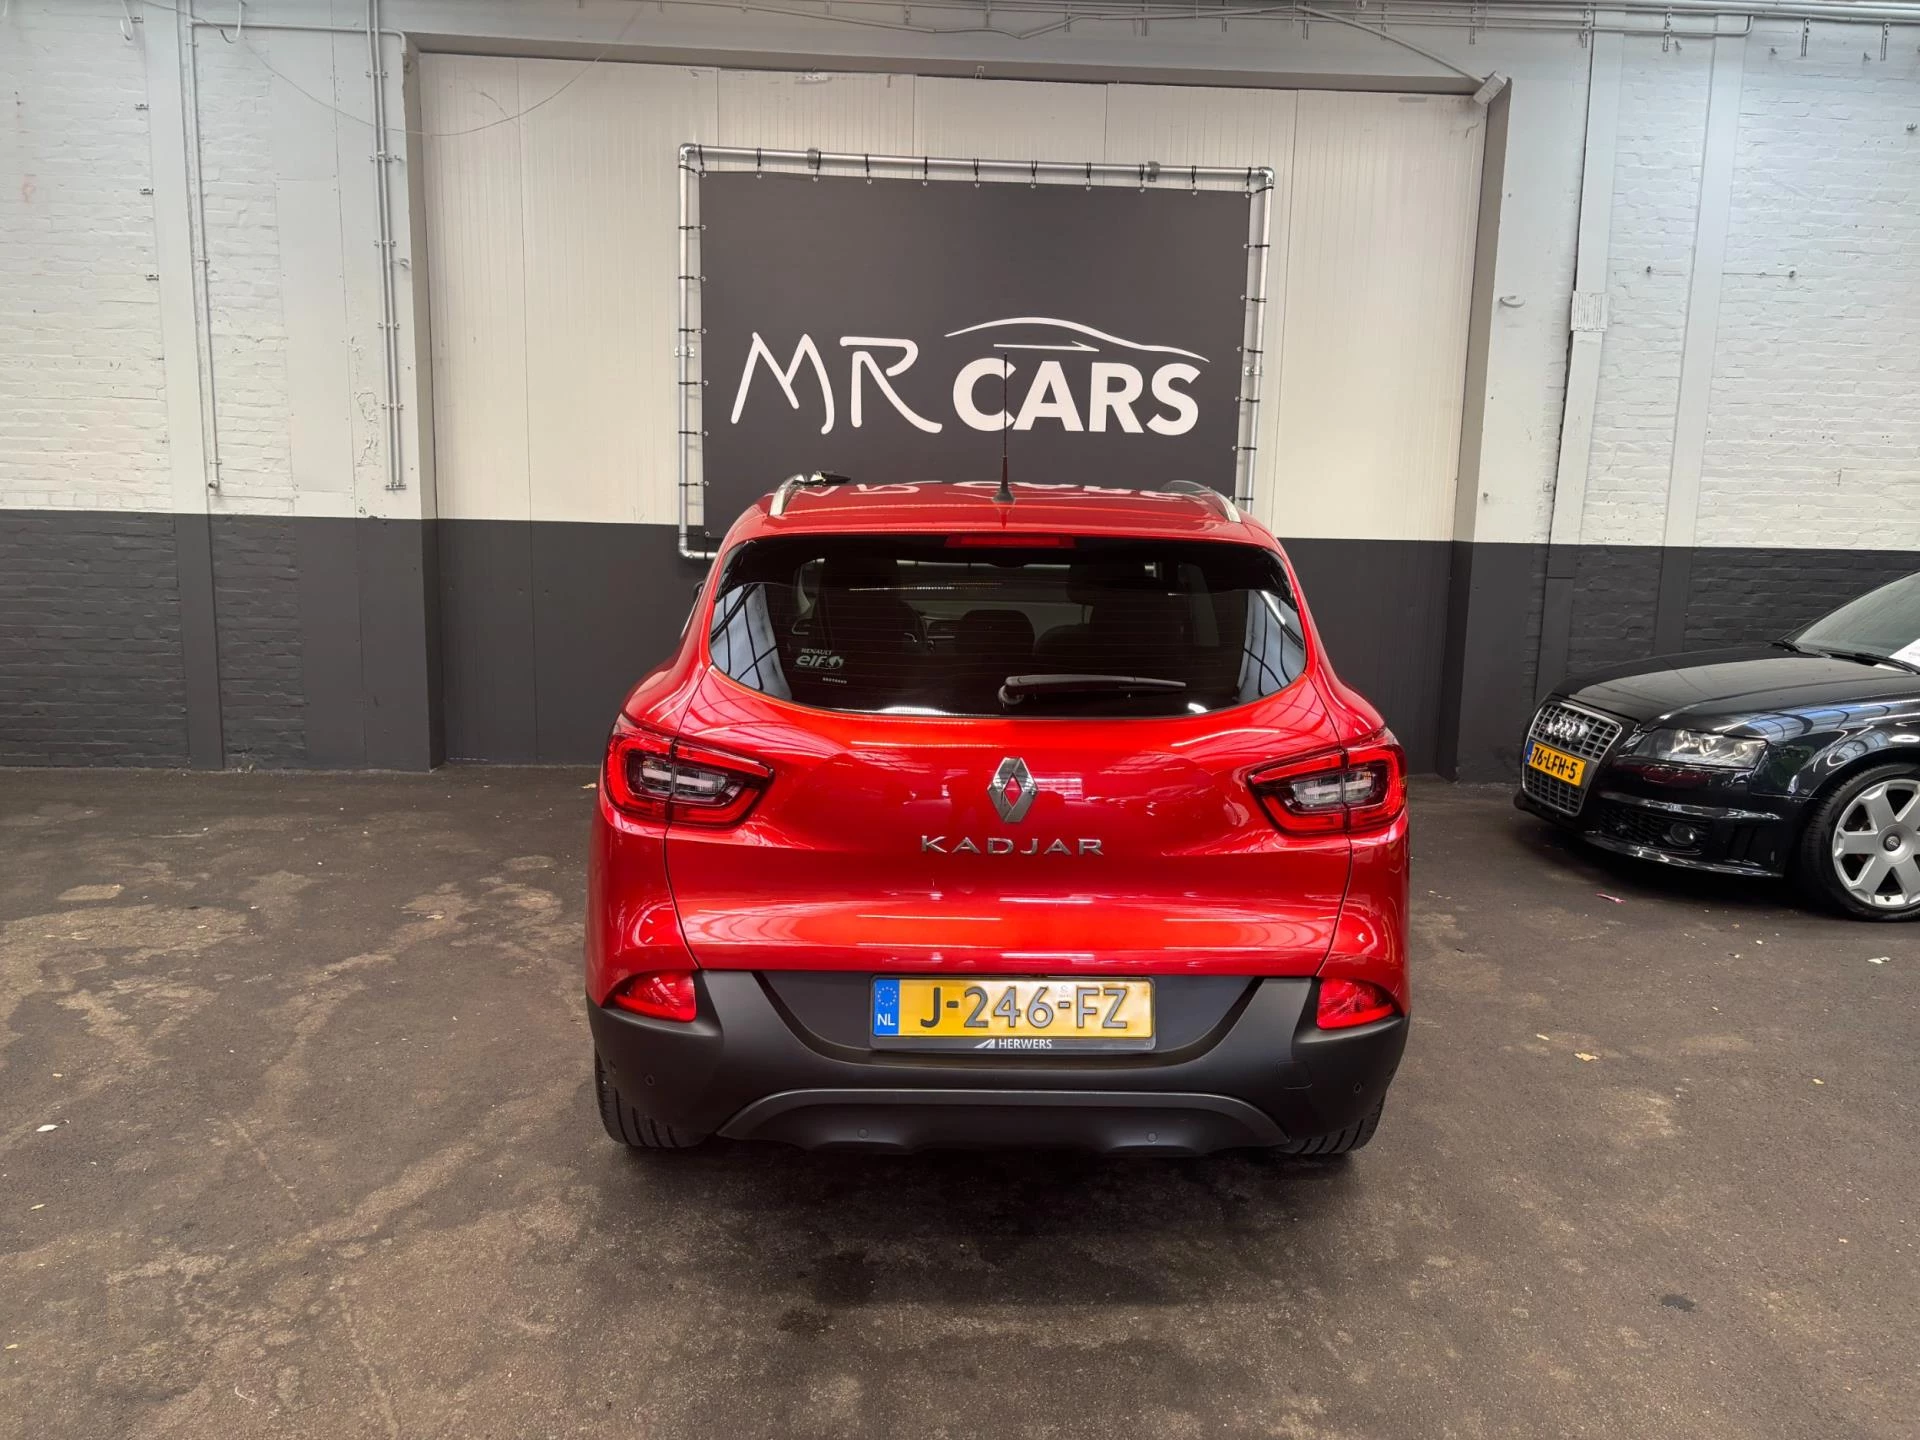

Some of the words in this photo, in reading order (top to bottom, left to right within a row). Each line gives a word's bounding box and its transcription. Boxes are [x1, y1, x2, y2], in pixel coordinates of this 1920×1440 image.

[731, 332, 943, 434] MR
[952, 357, 1201, 436] CARS
[1532, 747, 1578, 780] 76-LFH-5
[921, 835, 1104, 856] KADJAR
[877, 1013, 896, 1027] NL
[920, 986, 1128, 1029] J-246-FZ
[998, 1038, 1053, 1050] HERWERS
